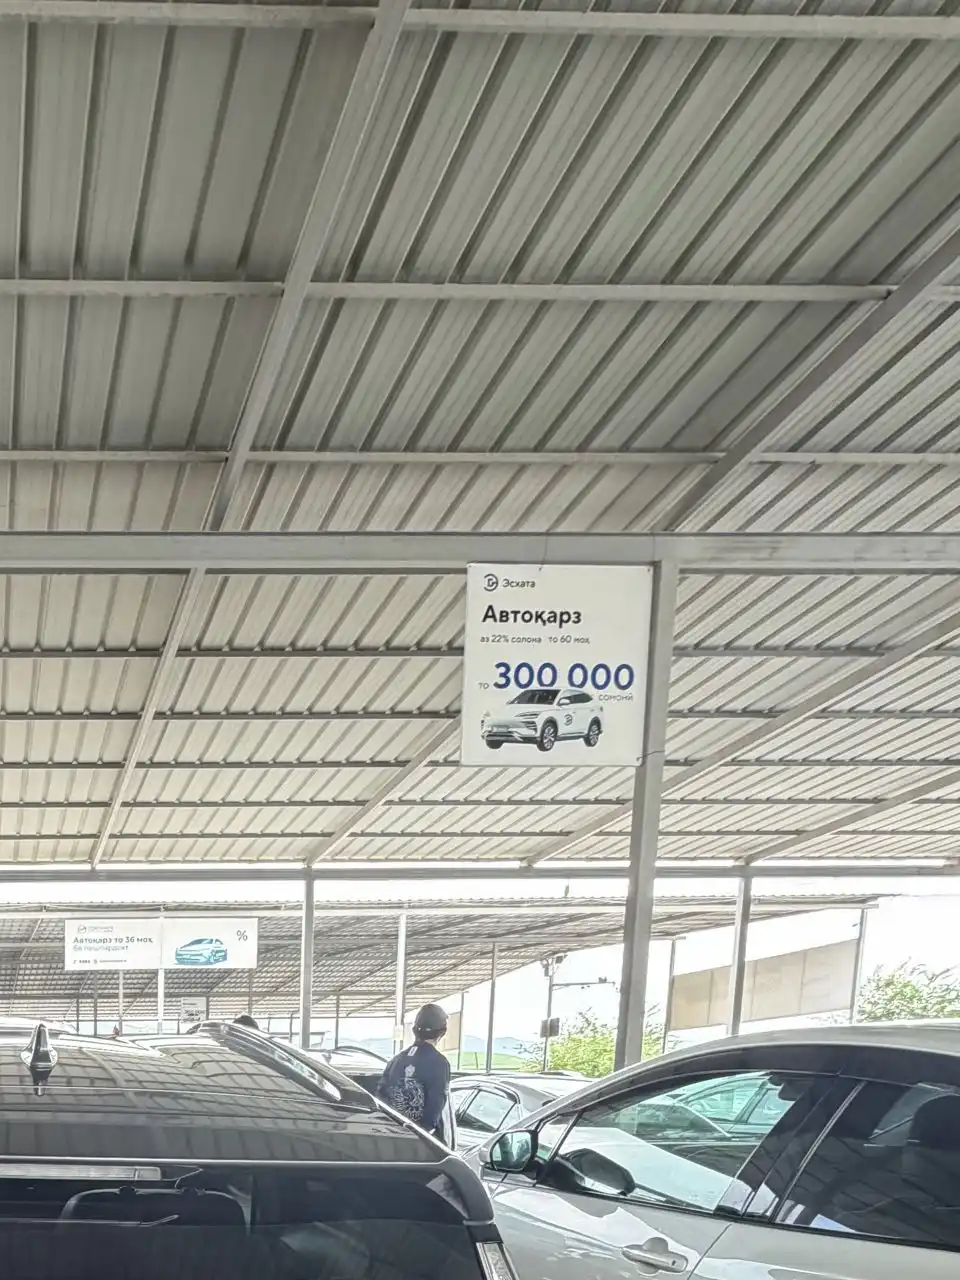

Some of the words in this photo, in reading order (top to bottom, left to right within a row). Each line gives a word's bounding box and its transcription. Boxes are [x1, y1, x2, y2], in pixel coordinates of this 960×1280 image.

[502, 578, 536, 588] Эсхата
[481, 604, 582, 629] Автоқарз
[491, 634, 509, 643] 22%
[548, 635, 558, 643] то
[560, 634, 572, 644] 60
[493, 661, 558, 690] 300
[567, 663, 634, 691] 000
